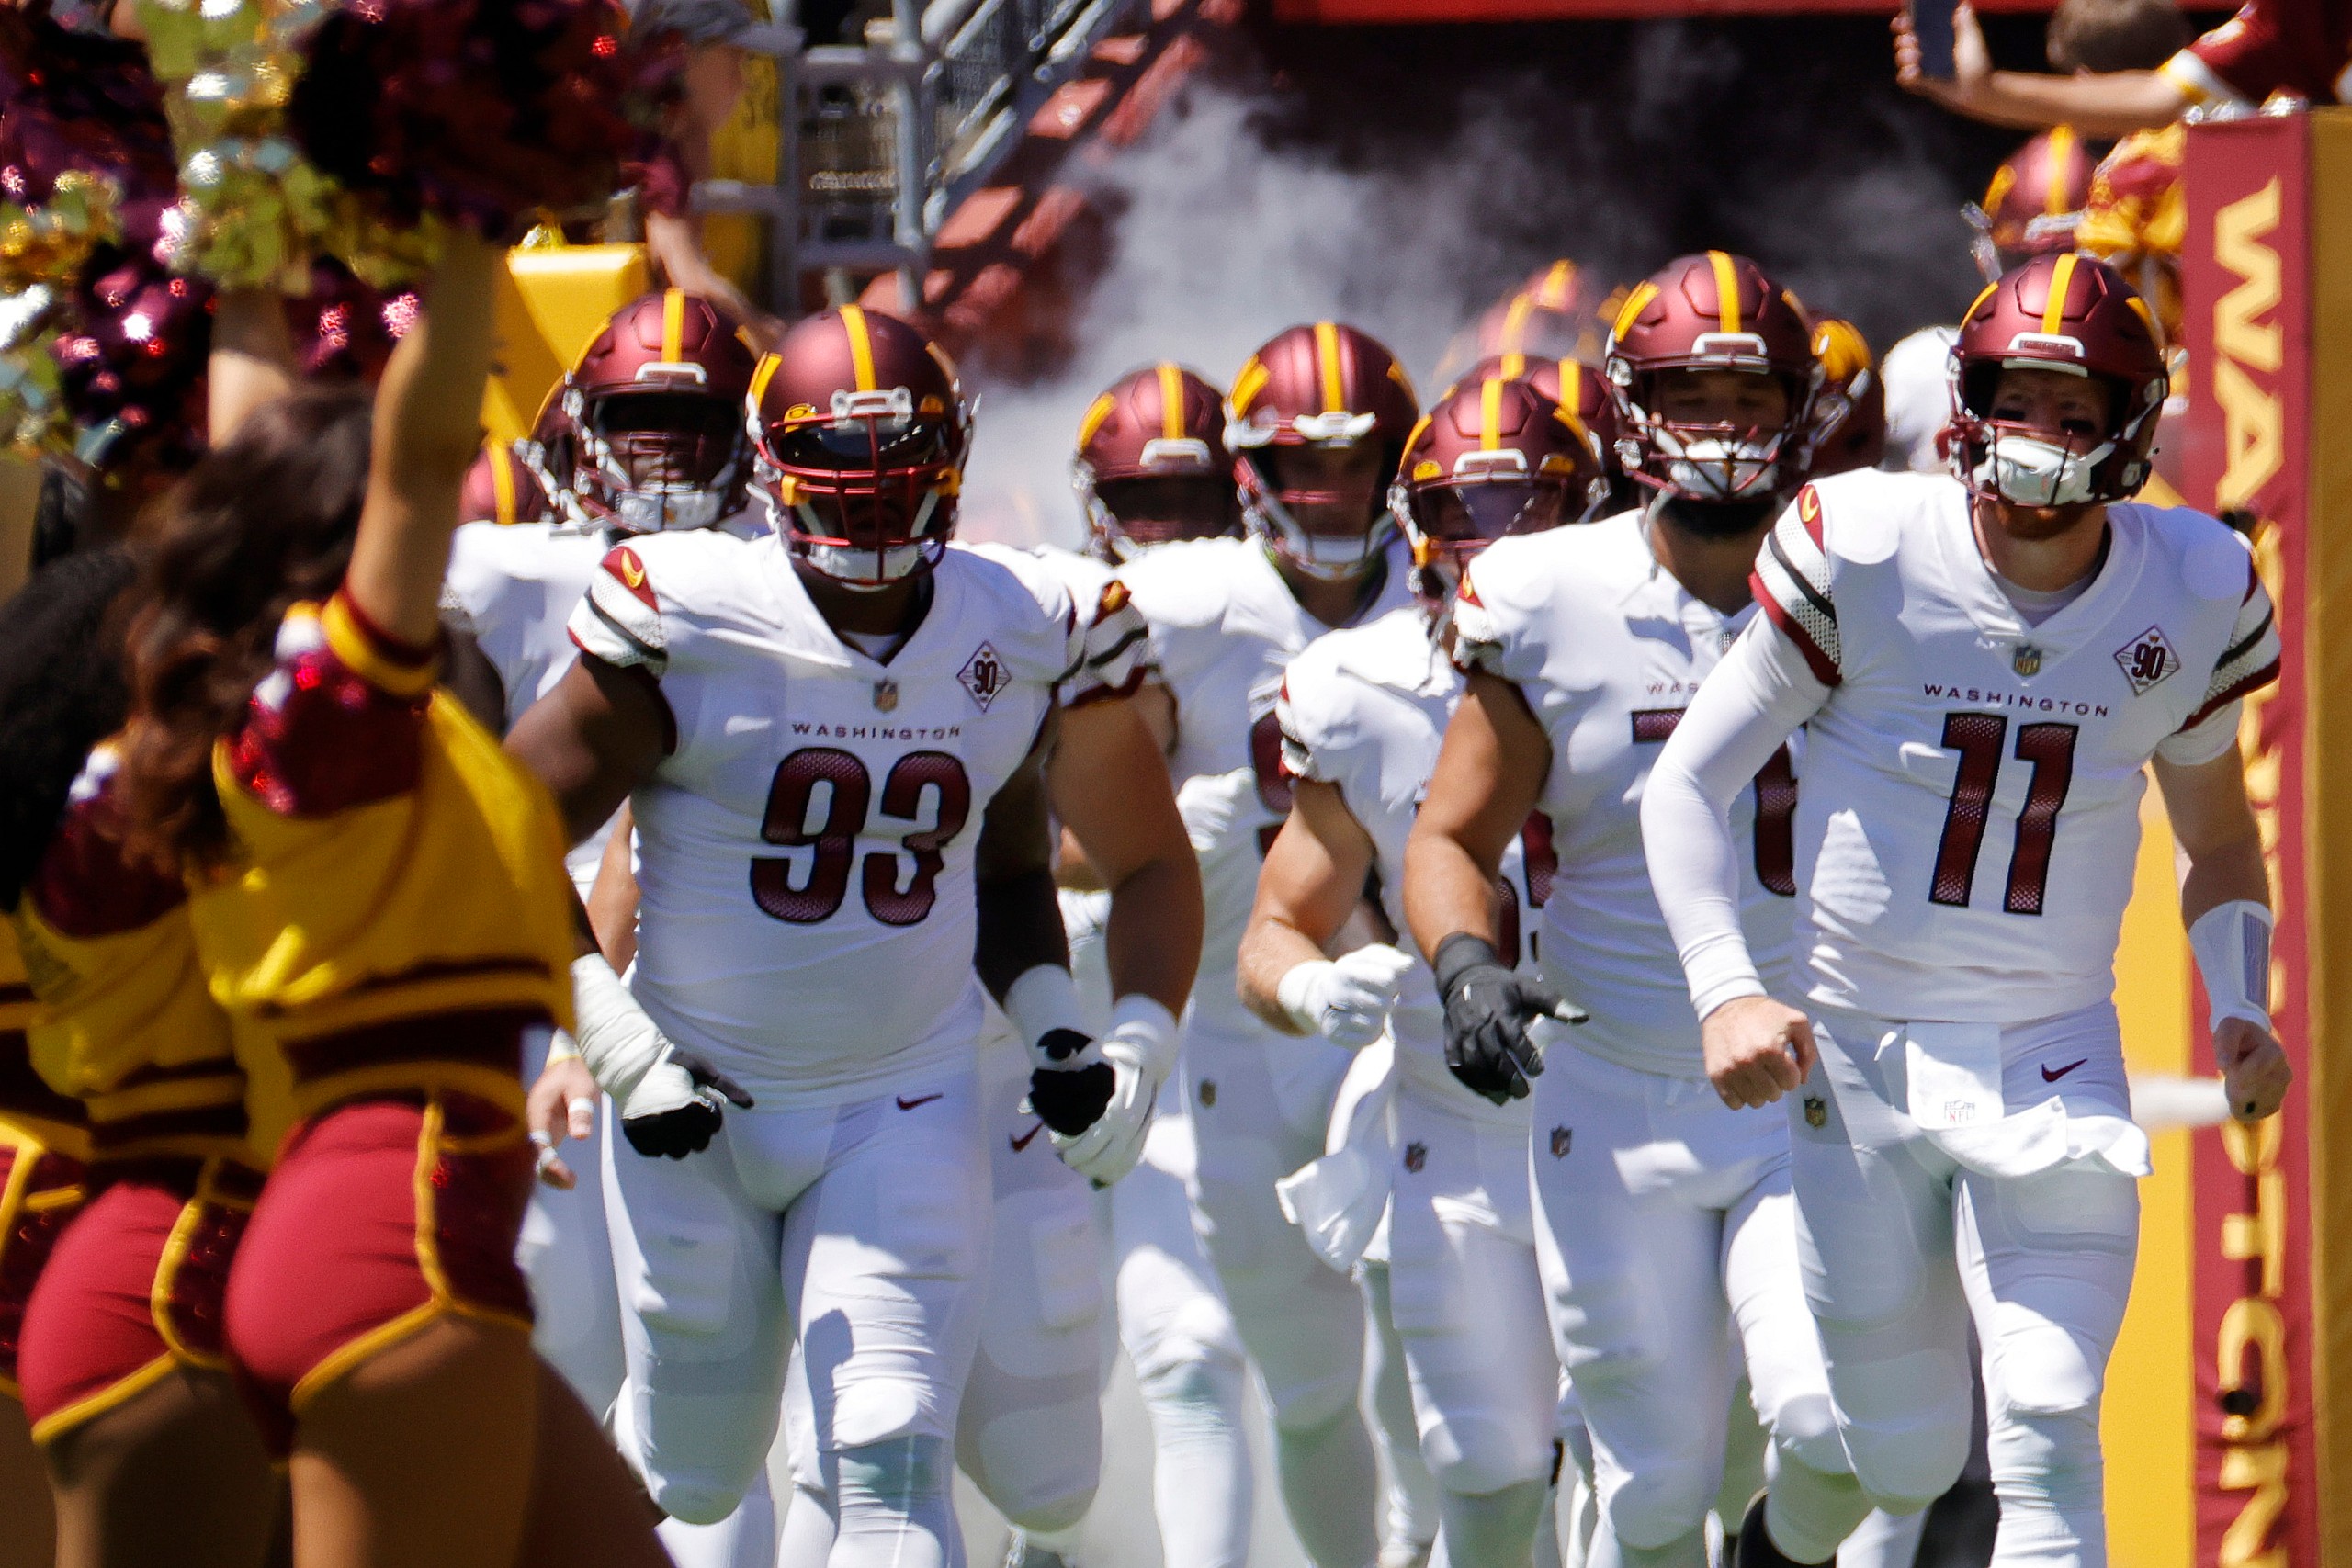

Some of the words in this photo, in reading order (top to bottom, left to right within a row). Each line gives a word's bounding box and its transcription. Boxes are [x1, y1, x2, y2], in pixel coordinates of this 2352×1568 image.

[973, 660, 998, 694] 90
[2132, 643, 2165, 681] 90
[1924, 683, 2109, 717] WASHINGTON
[791, 723, 961, 740] WASHINGTON
[1928, 712, 2080, 917] 11
[750, 747, 970, 926] 93
